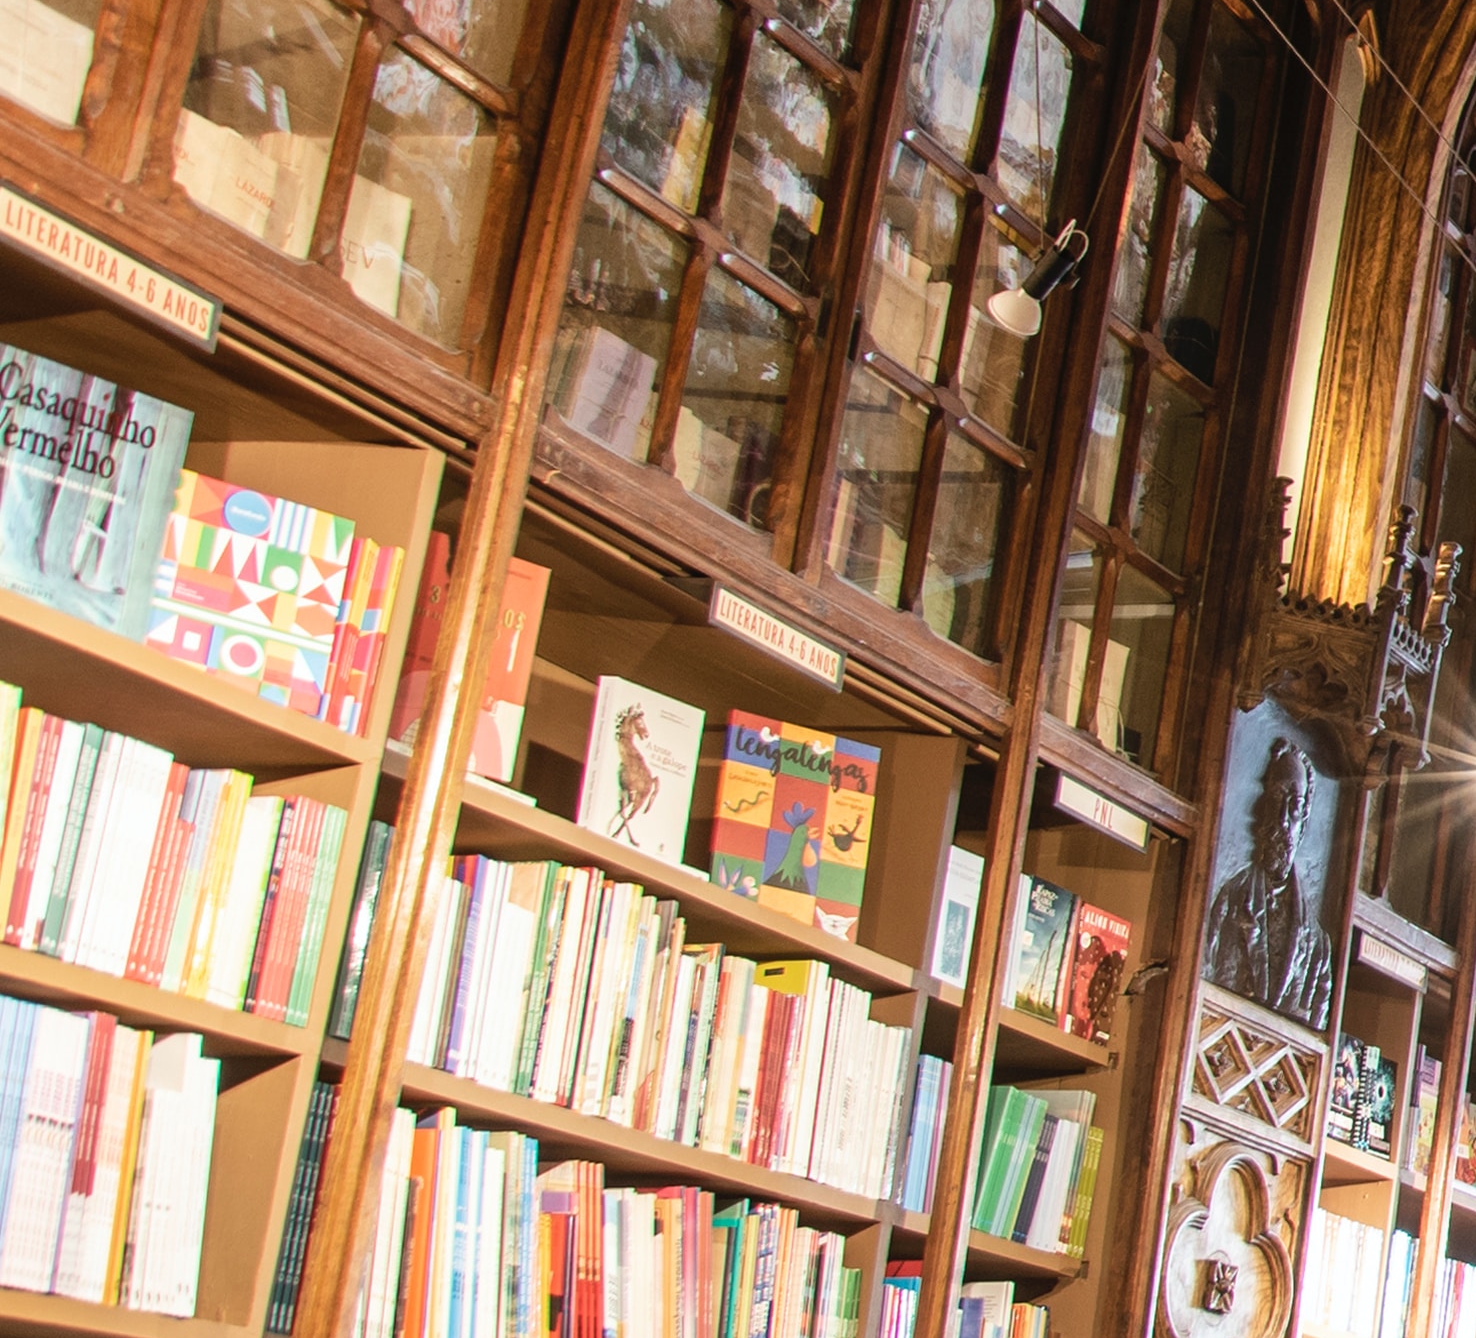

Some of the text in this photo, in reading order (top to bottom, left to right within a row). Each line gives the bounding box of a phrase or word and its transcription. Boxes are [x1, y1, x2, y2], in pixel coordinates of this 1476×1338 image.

[5, 200, 209, 333] LITERATURA 4-6 ANOS
[0, 363, 156, 449] Casaquinho
[719, 598, 837, 678] LITERATURA 4-6 ANOS
[736, 726, 870, 794] lengalengas
[1094, 797, 1114, 829] PNL
